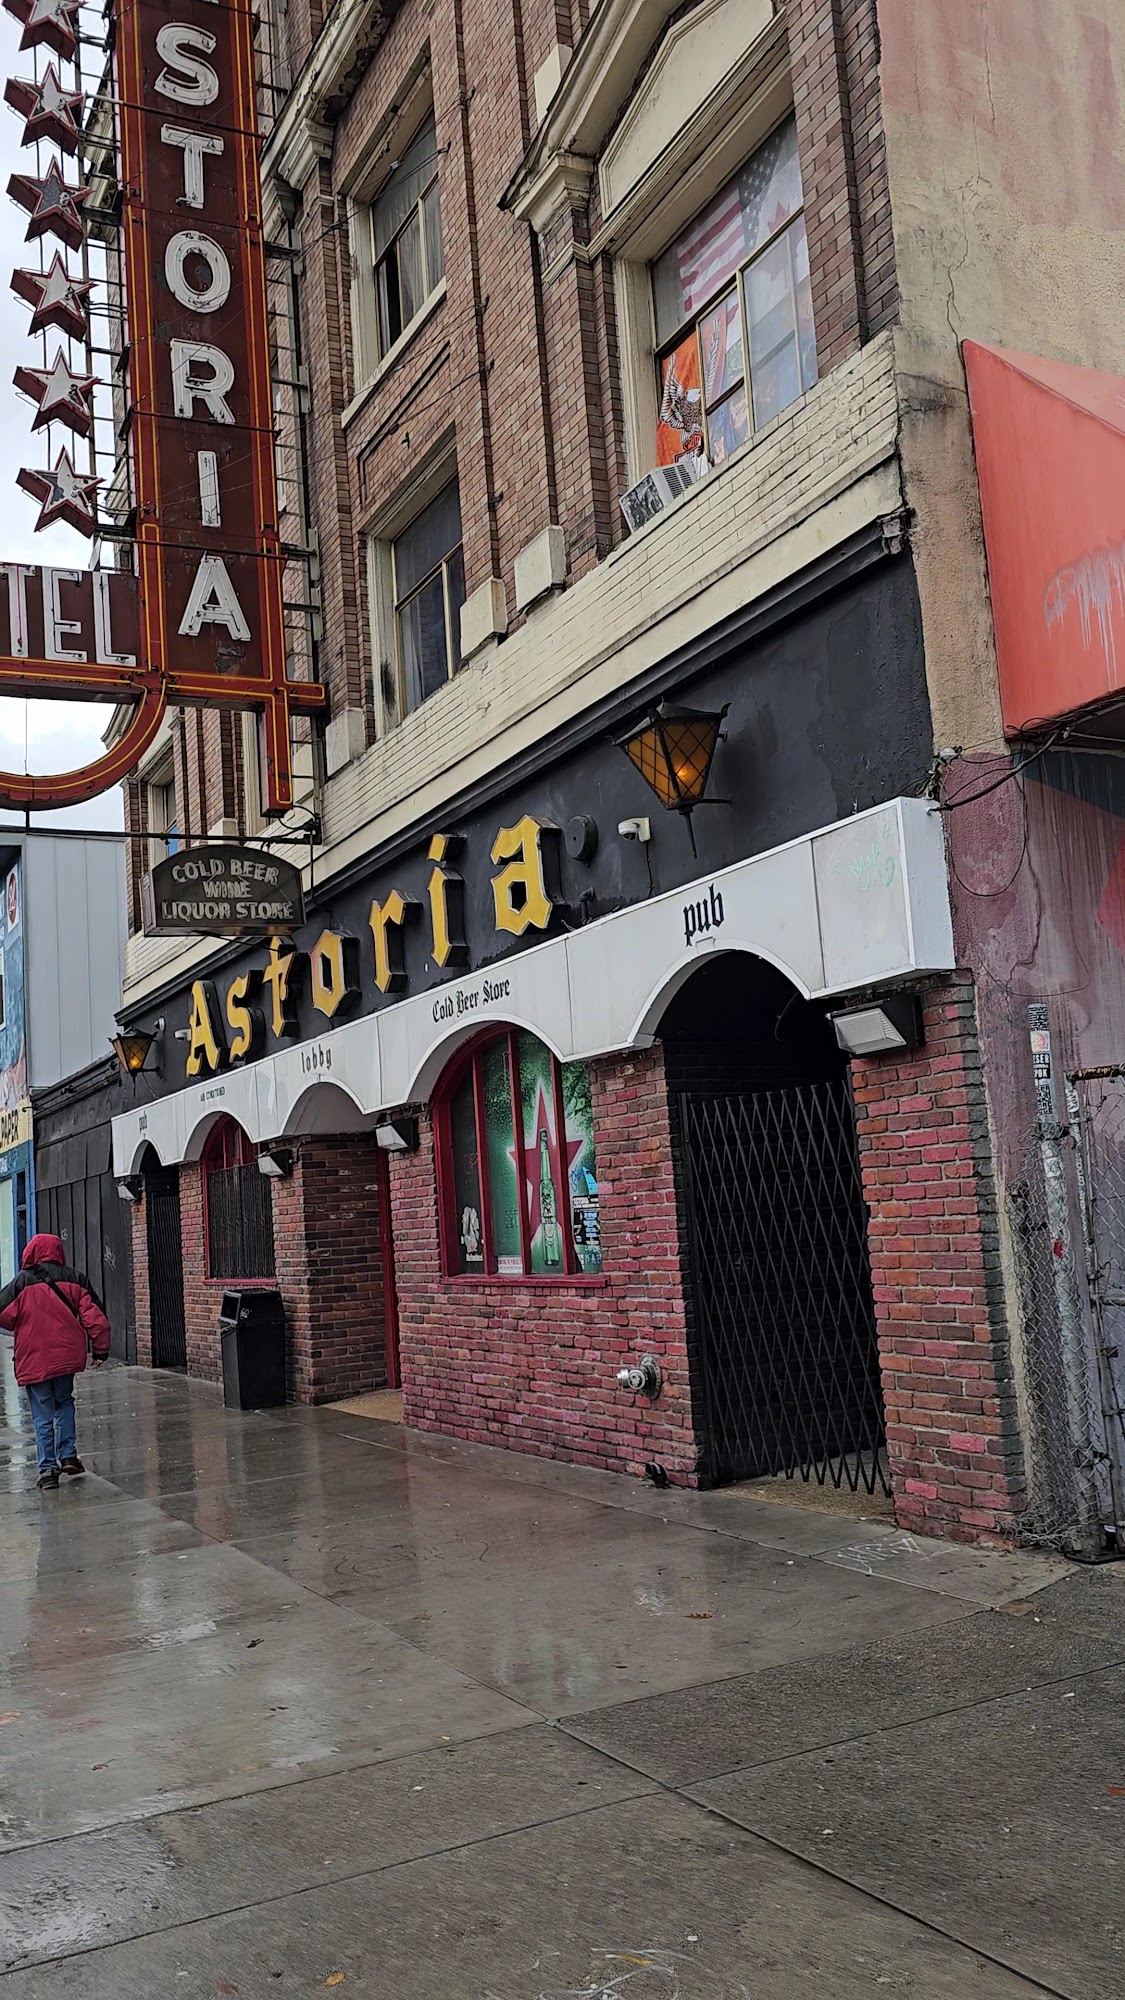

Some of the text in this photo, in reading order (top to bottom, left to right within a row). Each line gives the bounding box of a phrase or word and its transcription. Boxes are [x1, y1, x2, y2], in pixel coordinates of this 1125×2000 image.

[153, 0, 251, 641] STORIA
[172, 858, 279, 885] COLD BEER
[203, 880, 253, 899] WINE
[161, 901, 294, 922] LIQUOR STORE
[683, 883, 724, 947] pub
[186, 814, 556, 1077] Astoria
[432, 979, 511, 1022] Cold Beer Store
[300, 1044, 332, 1074] lobby
[139, 1109, 148, 1134] pub
